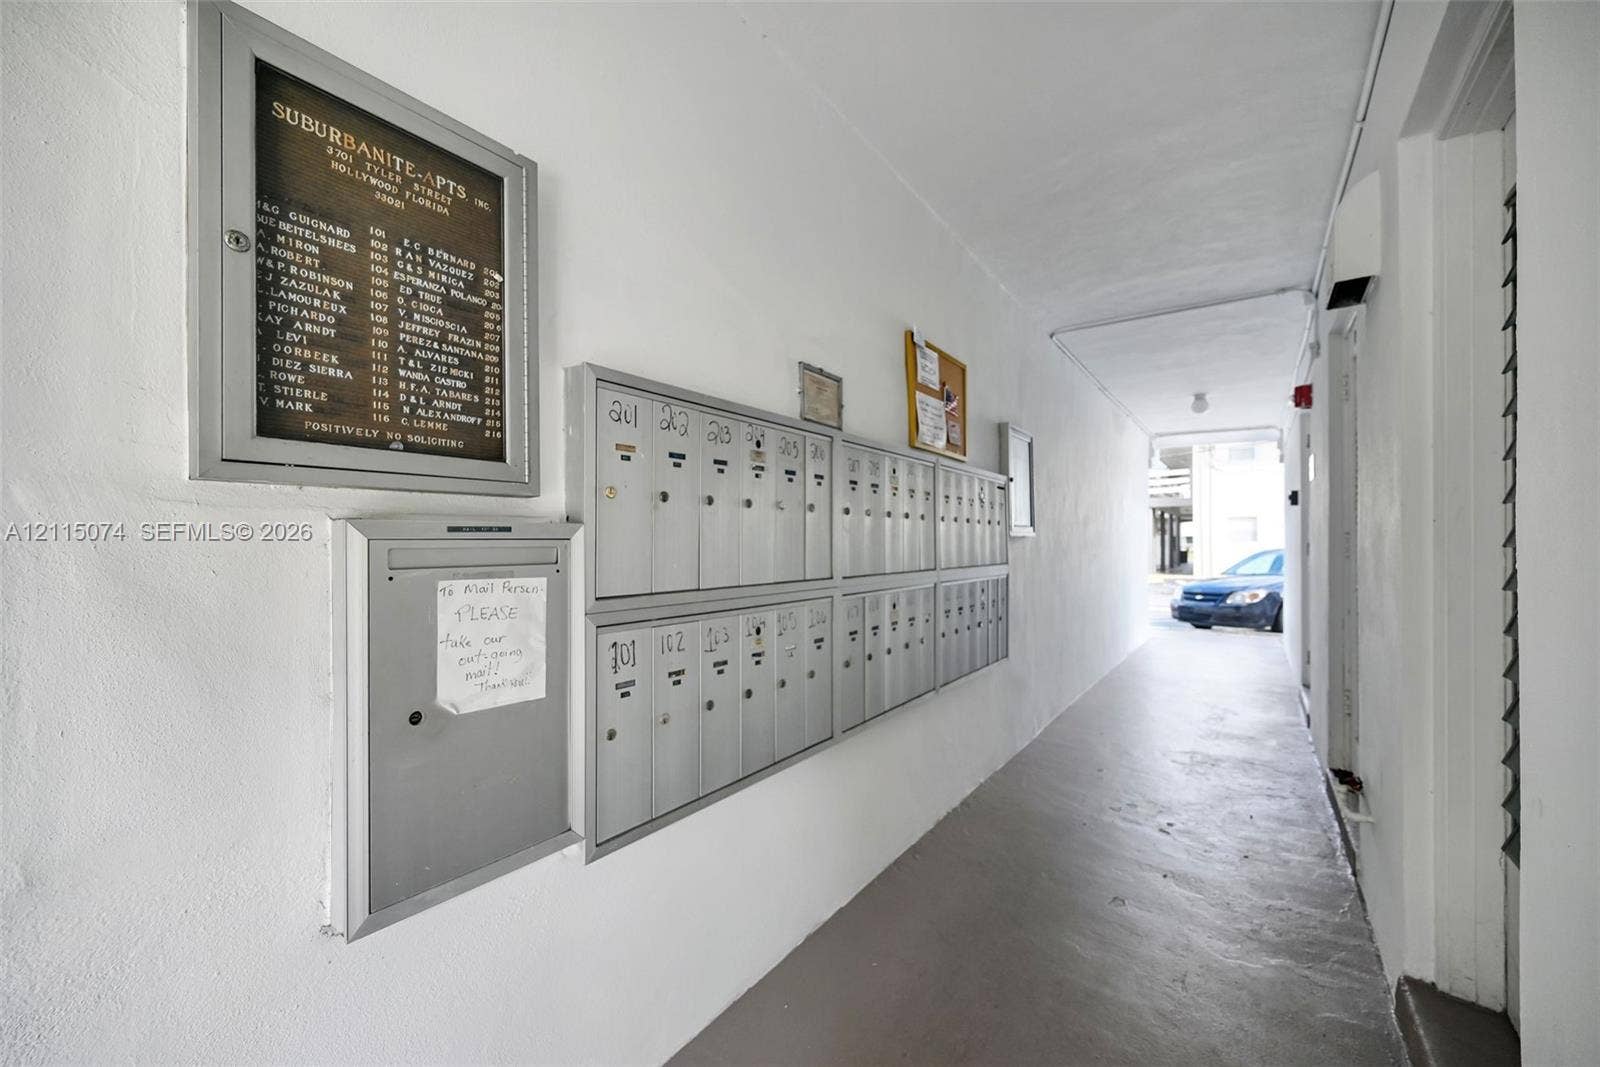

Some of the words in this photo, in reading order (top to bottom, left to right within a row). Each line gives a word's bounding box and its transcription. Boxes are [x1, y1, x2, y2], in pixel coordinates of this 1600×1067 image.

[326, 146, 354, 164] 3701
[365, 162, 402, 184] TYLER
[414, 182, 452, 206] STREET
[330, 160, 398, 194] HOLLYWOOD
[405, 190, 450, 216] FLORIDA
[374, 190, 405, 210] 33021
[278, 220, 356, 254] BEITELSHEES
[370, 252, 388, 264] 103
[289, 212, 350, 238] GUIGNARD
[370, 240, 388, 252] 102
[370, 226, 386, 238] 101
[270, 246, 320, 268] ROBERT
[371, 276, 389, 288] 105
[277, 234, 319, 254] MIRON
[371, 264, 389, 276] 104
[428, 247, 476, 270] BERNARD
[290, 264, 354, 290] ROBINSON
[370, 288, 388, 300] 106
[428, 259, 474, 281] VAZQUEZ
[484, 278, 500, 289] 202
[428, 270, 464, 289] MIRICA
[484, 290, 500, 299] 203
[280, 276, 341, 300] ZAZULAK
[370, 300, 388, 312] 107
[394, 271, 446, 294] ESPERANZA
[450, 288, 488, 306] POLANCO
[400, 284, 412, 295] ED
[418, 290, 442, 304] TRUE
[484, 310, 500, 321] 205
[269, 301, 336, 324] PICHARDO
[372, 326, 390, 336] 109
[270, 287, 348, 314] LAMOUREUX
[370, 313, 388, 324] 108
[276, 330, 307, 346] LEVI
[372, 350, 388, 362] 111
[293, 320, 336, 338] ARNDT
[372, 338, 388, 349] 110
[398, 321, 440, 338] JEFFREY
[448, 333, 482, 348] FRAZIN
[484, 343, 500, 352] 208
[484, 332, 500, 342] 207
[272, 358, 302, 370] DIEZ
[308, 364, 353, 380] SIERRA
[372, 376, 388, 386] 113
[372, 363, 388, 374] 112
[414, 348, 460, 366] ALVARES
[484, 365, 500, 374] 210
[270, 370, 305, 384] ROWE
[373, 388, 390, 398] 114
[398, 368, 430, 382] WANDA
[434, 376, 467, 389] CASTRO
[484, 386, 500, 396] 212
[484, 376, 499, 385] 211
[274, 384, 328, 402] STIERLE
[373, 401, 390, 410] 115
[276, 399, 314, 412] MARK
[373, 413, 390, 422] 116
[432, 400, 462, 412] ARNDT
[484, 408, 500, 417] 214
[435, 388, 480, 403] TABARES
[484, 397, 500, 406] 213
[416, 408, 482, 426] ALEXANDROFF
[608, 400, 638, 428] 201
[660, 403, 690, 438] 202
[304, 421, 380, 438] POSITIVELY
[387, 432, 402, 441] NO
[407, 434, 464, 448] SOLICITING
[414, 419, 448, 432] LEMME
[484, 430, 502, 438] 216
[707, 420, 732, 444] 203
[779, 437, 799, 460] 205
[464, 582, 494, 595] Mail
[454, 604, 520, 622] PLEASE
[440, 633, 472, 650] take
[484, 636, 508, 646] our
[661, 632, 686, 655] 102
[704, 626, 730, 653] 103
